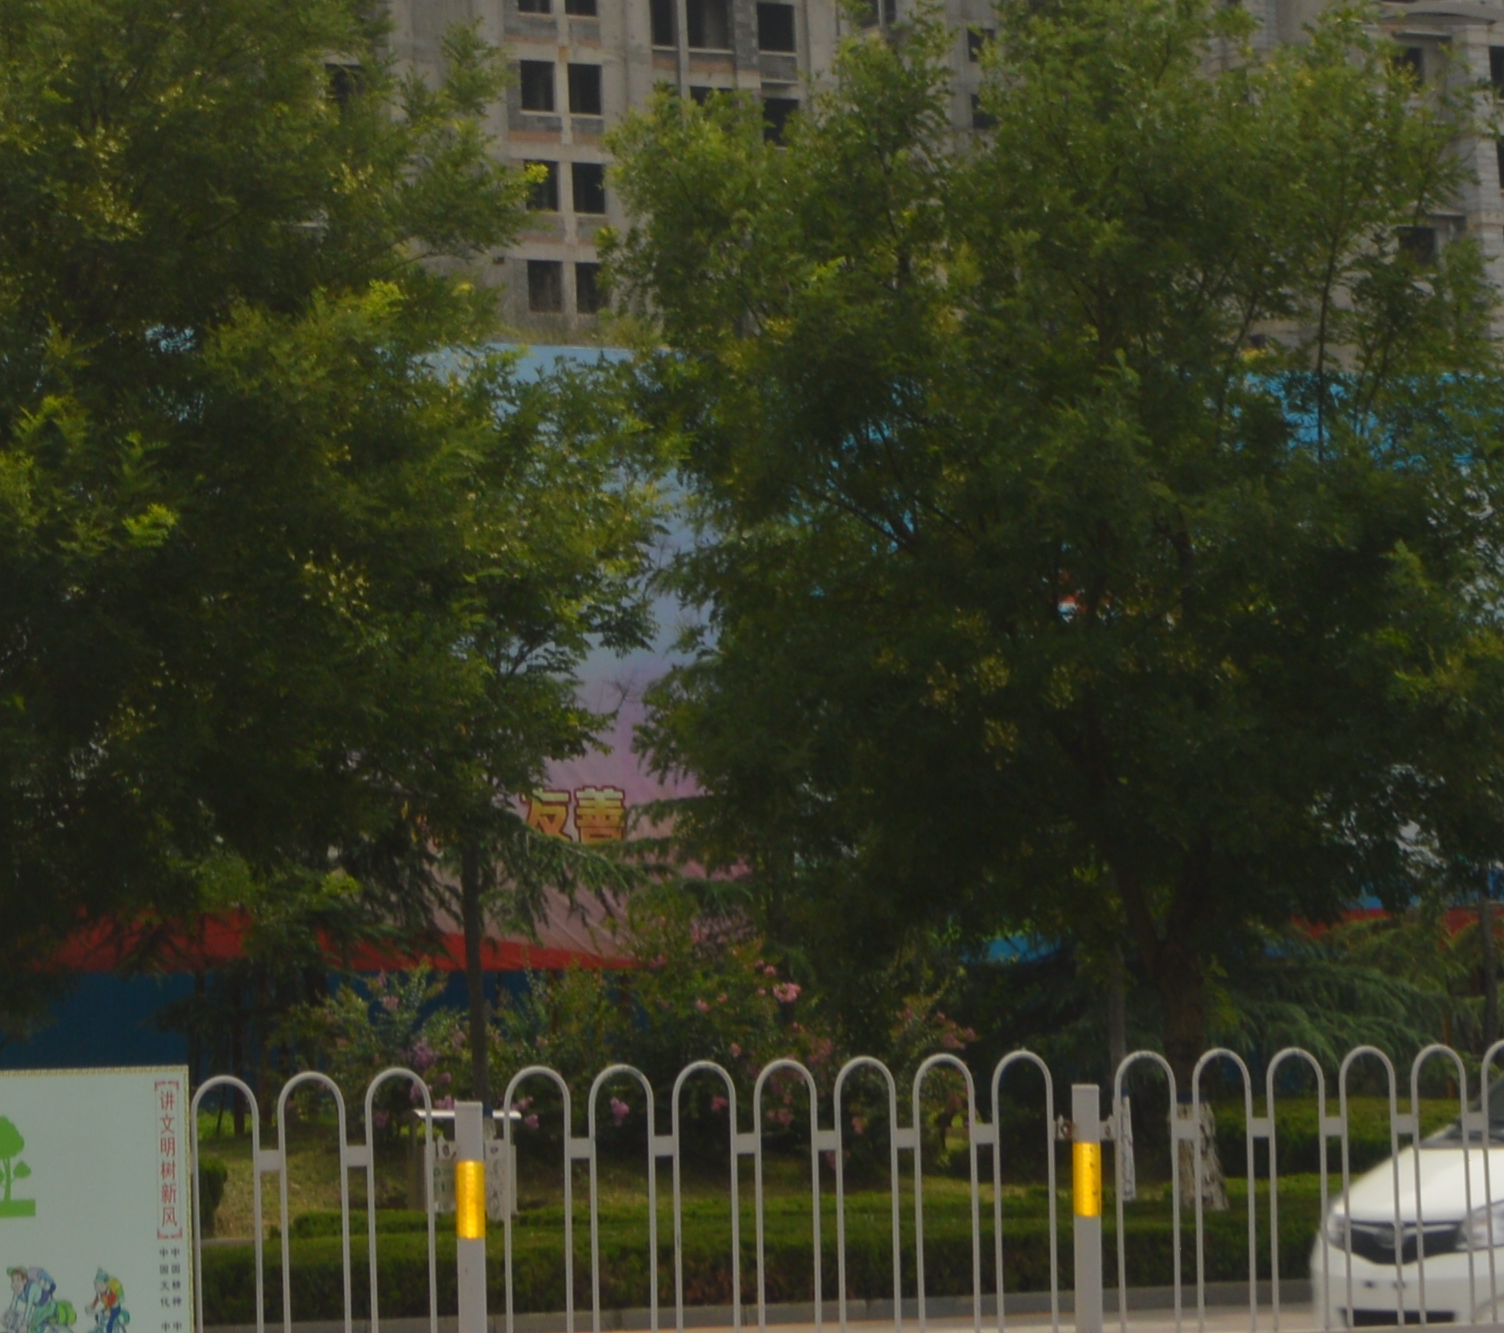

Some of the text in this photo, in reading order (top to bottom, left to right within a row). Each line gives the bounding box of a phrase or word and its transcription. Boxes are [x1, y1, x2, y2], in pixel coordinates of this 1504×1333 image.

[519, 786, 626, 845] 友善
[160, 1090, 177, 1228] 讲文明树新风
